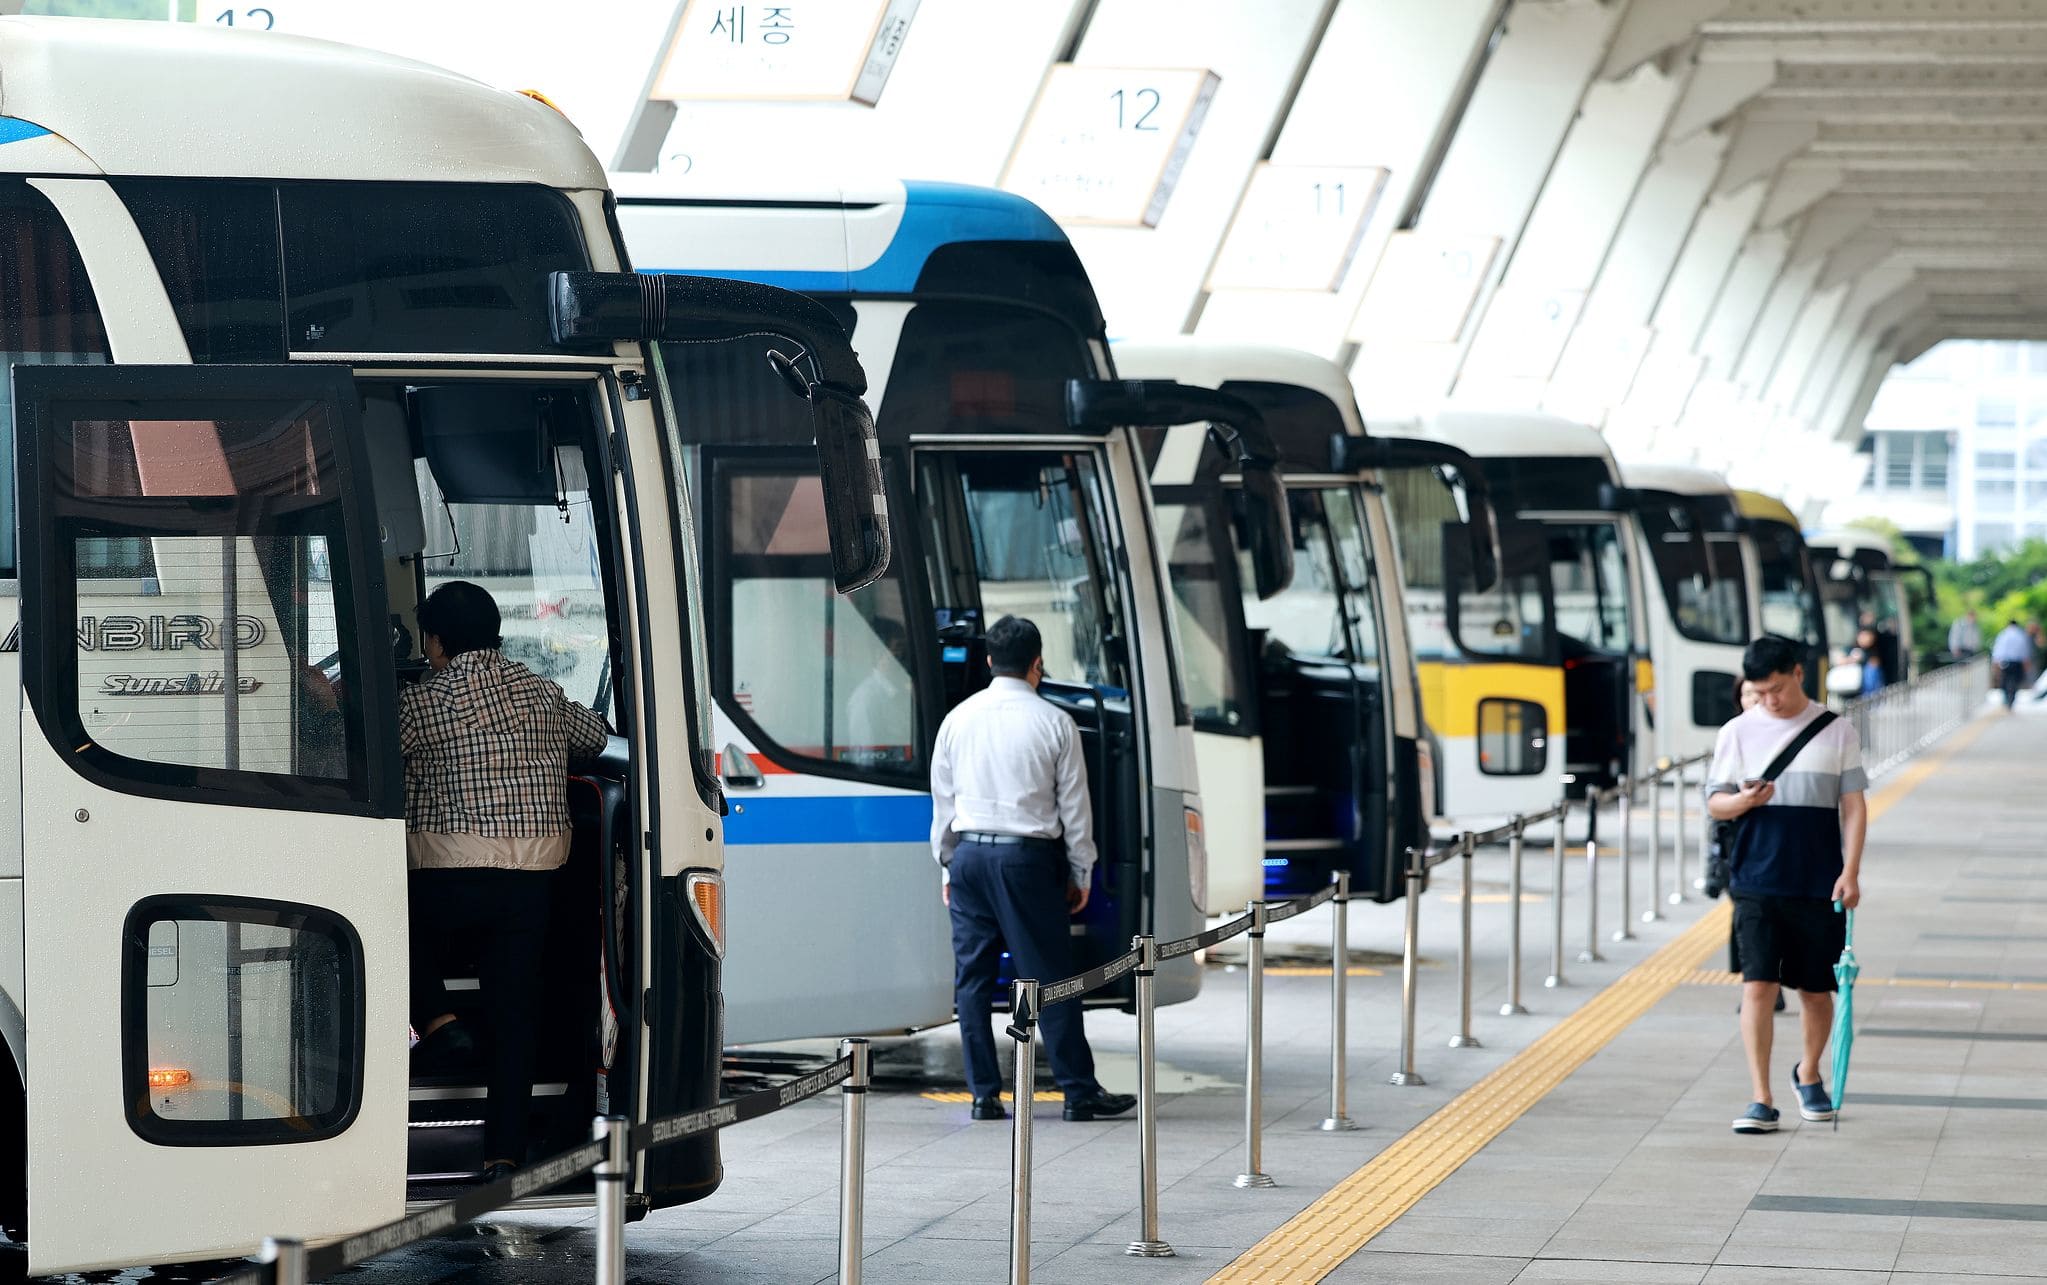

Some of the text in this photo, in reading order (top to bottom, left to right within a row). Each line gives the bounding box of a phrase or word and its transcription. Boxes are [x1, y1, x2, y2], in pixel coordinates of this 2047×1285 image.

[710, 6, 794, 44] 세종
[1110, 88, 1160, 130] 12
[1314, 184, 1344, 216] 11
[149, 947, 175, 957] ESEL
